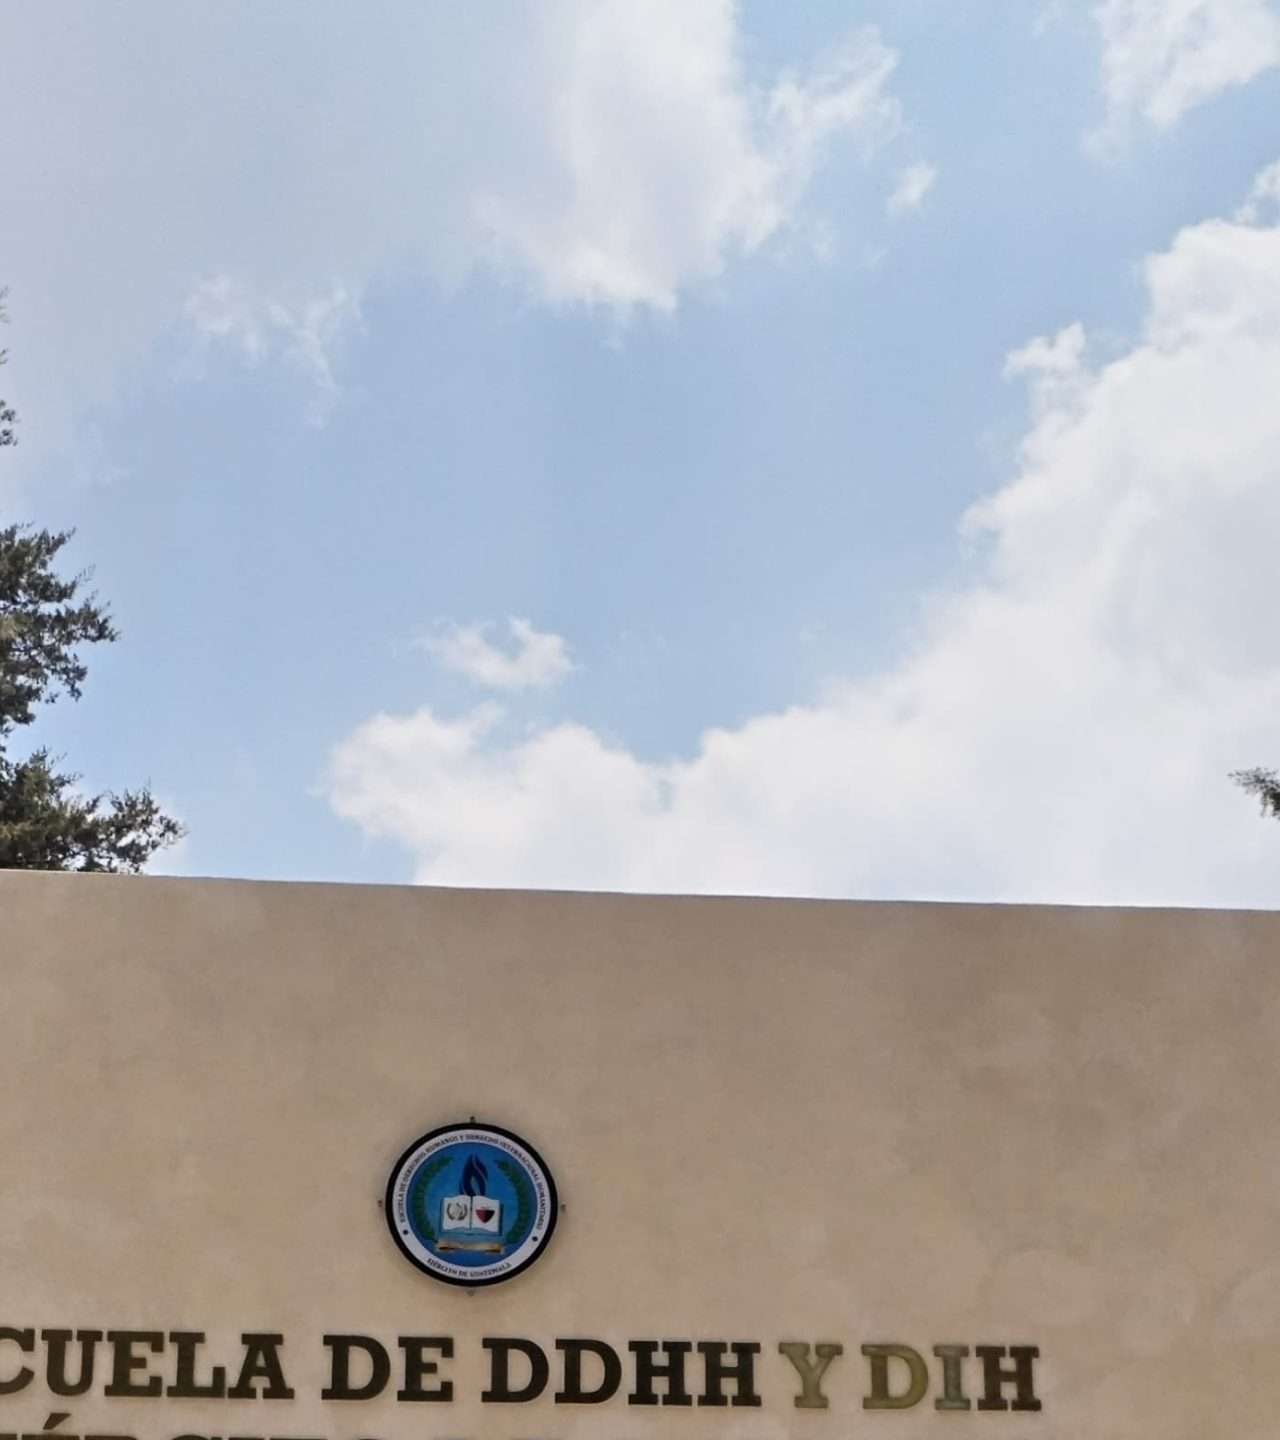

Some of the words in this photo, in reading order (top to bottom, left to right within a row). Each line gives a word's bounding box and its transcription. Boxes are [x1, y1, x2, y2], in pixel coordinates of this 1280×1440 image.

[321, 1334, 455, 1403] DE
[481, 1337, 762, 1408] DDHH
[778, 1341, 843, 1410] Y
[861, 1343, 1042, 1413] DIH
